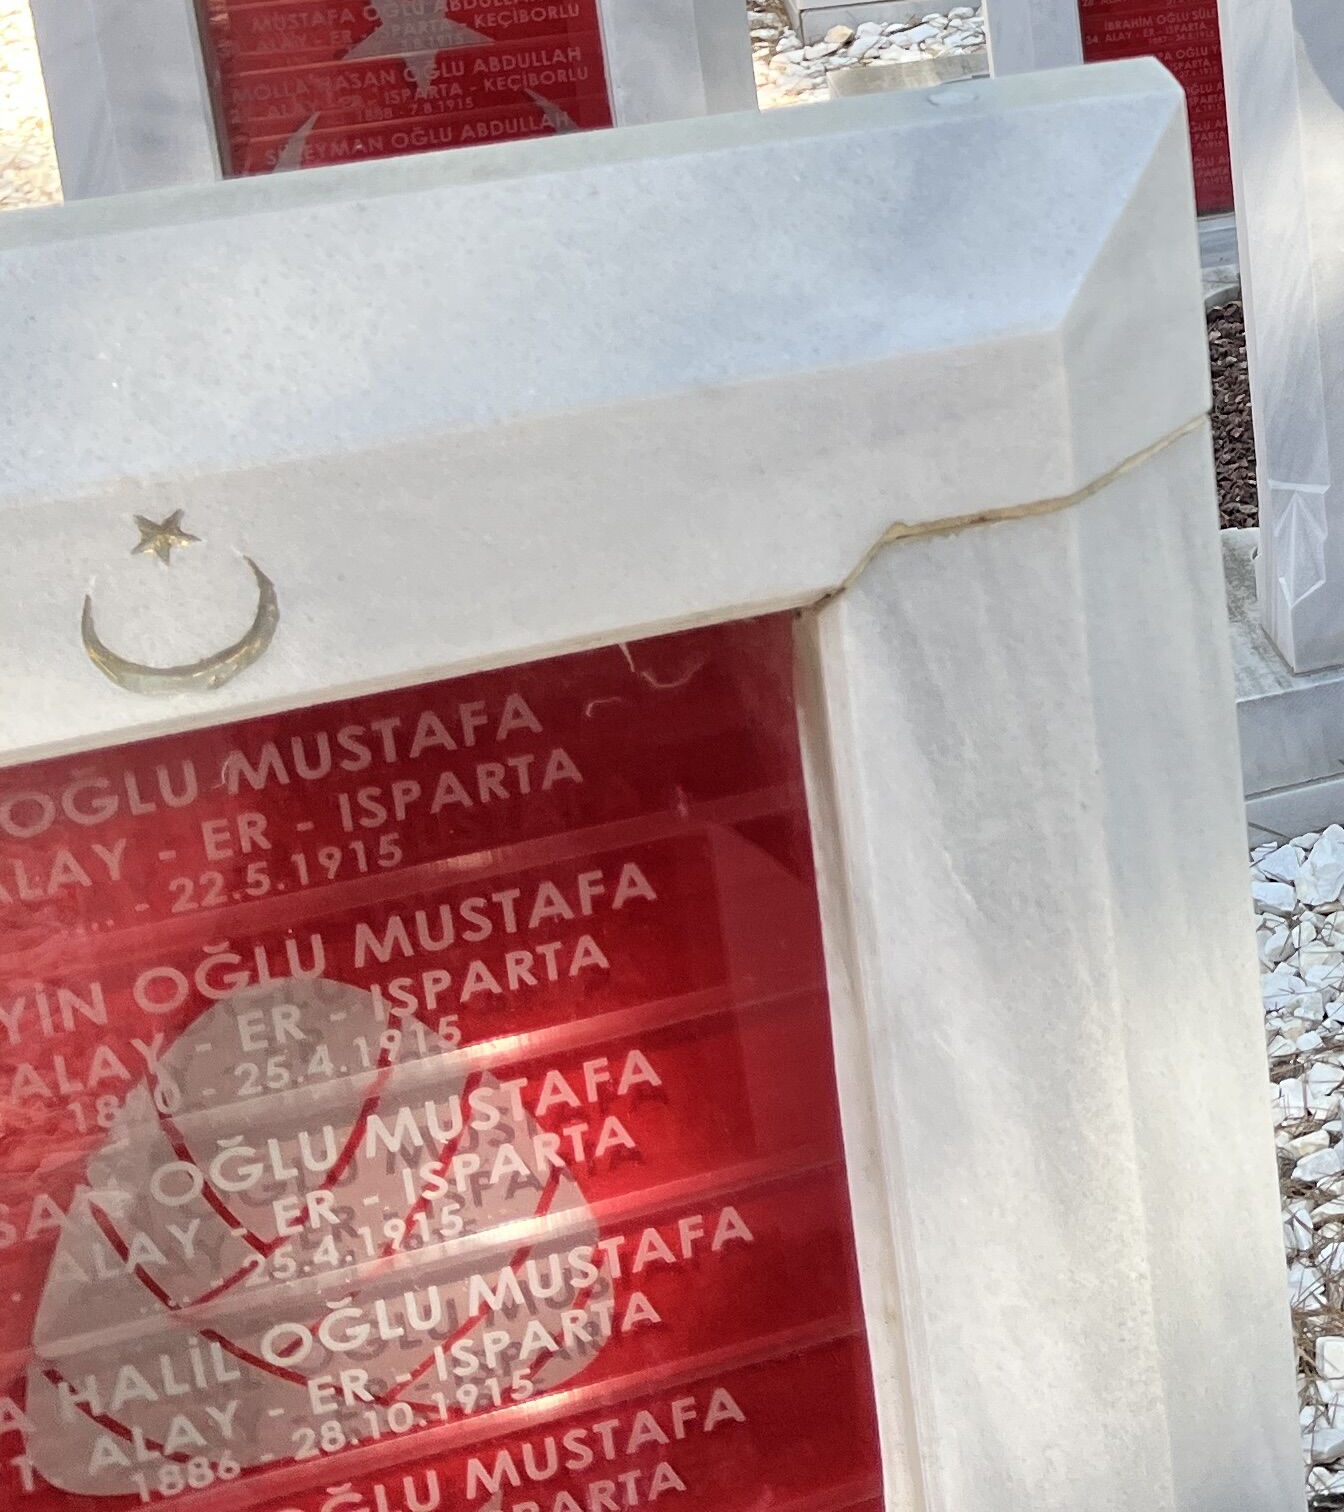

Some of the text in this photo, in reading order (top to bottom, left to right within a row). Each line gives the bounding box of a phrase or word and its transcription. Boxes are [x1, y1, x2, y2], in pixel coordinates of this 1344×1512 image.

[473, 46, 582, 74] ABDULLAH
[474, 3, 581, 28] KEÇİBORLU
[392, 110, 569, 149] OĞLU ABDULLAH
[483, 65, 589, 93] KEÇİBORLU
[2, 692, 544, 839] OĞLU MUSTAFA
[201, 747, 584, 862] ER ISPARTA
[171, 831, 403, 914] 22.5.1915
[133, 933, 327, 1014] OĞLU
[354, 861, 658, 969] MUSTAFA
[10, 933, 611, 1105] ALAY ER ISPARTA
[234, 1014, 463, 1095] 25.4.1915
[150, 1049, 663, 1207] OĞLU MUSTAFA
[50, 1115, 637, 1286] ALAY ER ISPARTA
[244, 1204, 467, 1288] 25.4.1915
[58, 1206, 755, 1422] HALİL OĞLU MUSTAFA
[88, 1292, 662, 1477] ALAY ER ISPARTA
[129, 1367, 537, 1503] 1886 28.10.1915
[465, 1387, 748, 1501] MUSTAFA
